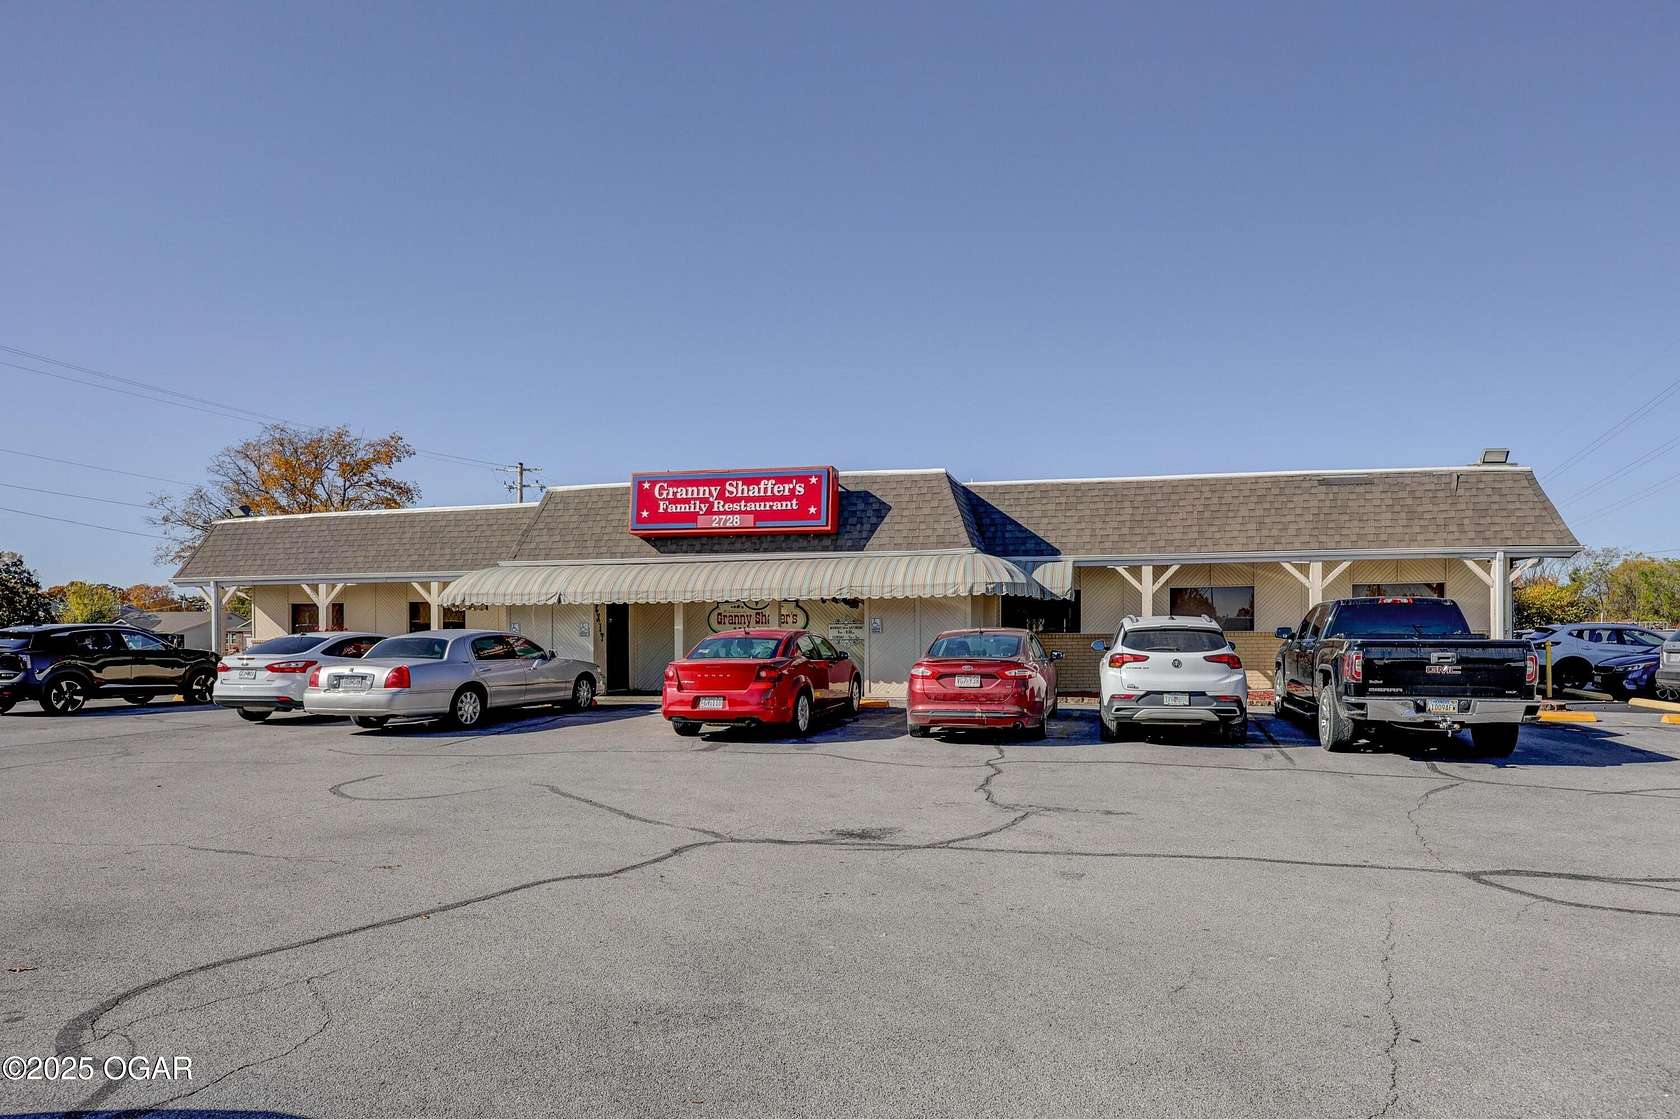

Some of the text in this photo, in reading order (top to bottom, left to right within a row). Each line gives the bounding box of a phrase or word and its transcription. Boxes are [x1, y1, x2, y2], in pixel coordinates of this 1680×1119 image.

[655, 479, 805, 501] Granny Shaffer's
[658, 499, 799, 514] Family Restaurant
[711, 515, 740, 527] 2728
[716, 611, 798, 627] Granny Sher's
[1425, 665, 1461, 674] GMC
